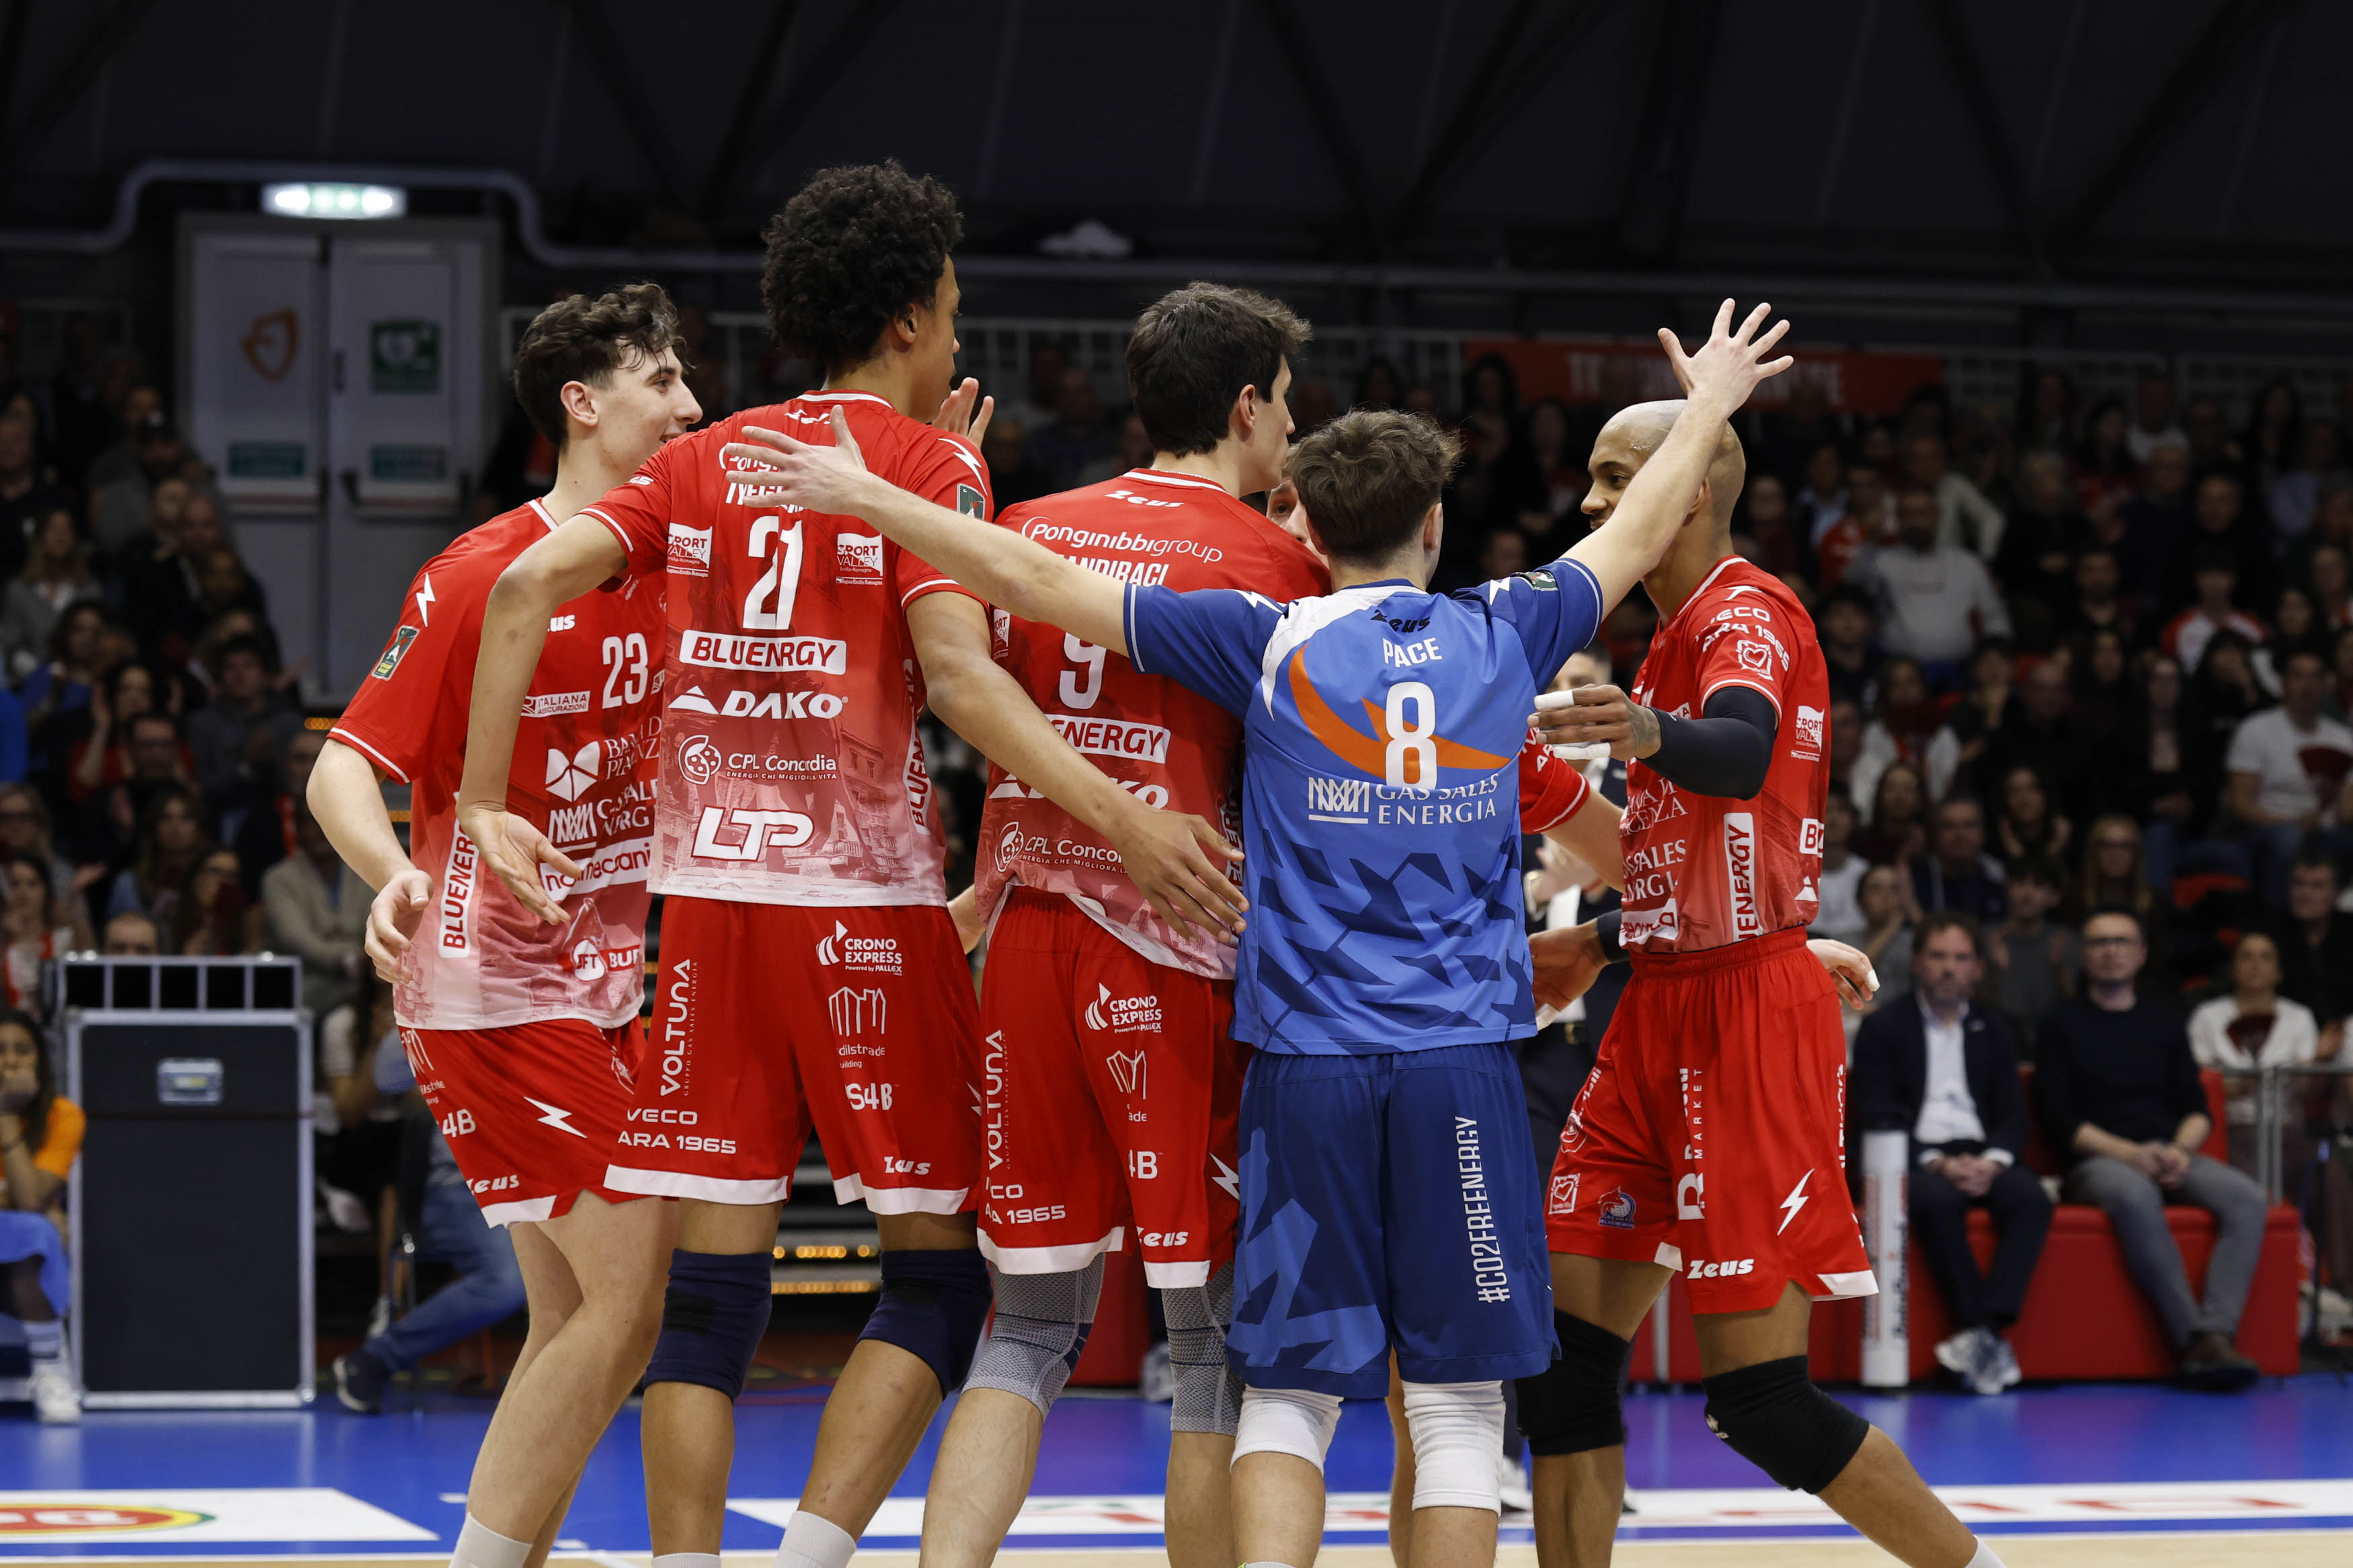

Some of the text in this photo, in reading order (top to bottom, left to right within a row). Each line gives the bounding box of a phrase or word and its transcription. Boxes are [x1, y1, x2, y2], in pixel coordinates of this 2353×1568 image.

[1105, 490, 1185, 508] Zeus
[838, 544, 879, 556] SPORT
[1030, 523, 1223, 564] Ponginibbigroup
[837, 556, 878, 567] VALLEY
[743, 515, 803, 630] 21
[691, 636, 837, 667] BLUENRGY
[1382, 637, 1443, 668] PACE
[602, 632, 649, 709] 23
[1059, 632, 1107, 710] 9
[539, 694, 588, 708] ITALIANA
[720, 690, 844, 719] DAKO
[1796, 717, 1823, 731] SPORT
[1386, 682, 1438, 789] 8
[728, 753, 760, 770] CPL
[727, 771, 758, 779] ENERGIA
[1375, 773, 1499, 800] GAS SALES
[1378, 798, 1497, 825] ENERGIA
[691, 805, 814, 861] LTP
[1025, 836, 1052, 855] CPL
[1019, 854, 1050, 864] ENERGIA
[1074, 860, 1117, 872] MIGLIORA
[844, 938, 897, 950] CRONO
[845, 951, 902, 964] EXPRESS
[875, 964, 902, 973] PALLEX
[1109, 995, 1158, 1012] CRONO
[660, 958, 690, 1096] VOLTUNA
[1111, 1008, 1162, 1026] EXPRESS
[1114, 1025, 1137, 1034] Powered
[836, 1044, 885, 1056] dilstrade
[840, 1061, 863, 1069] uilding
[683, 1060, 692, 1096] GRUPPO
[844, 1083, 893, 1110] S4B
[986, 1029, 1004, 1171] VOLTUNA
[1693, 1069, 1703, 1159] MARKET
[676, 1135, 737, 1155] 1965
[1006, 1204, 1066, 1225] 1965
[1687, 1258, 1755, 1280] Zeus
